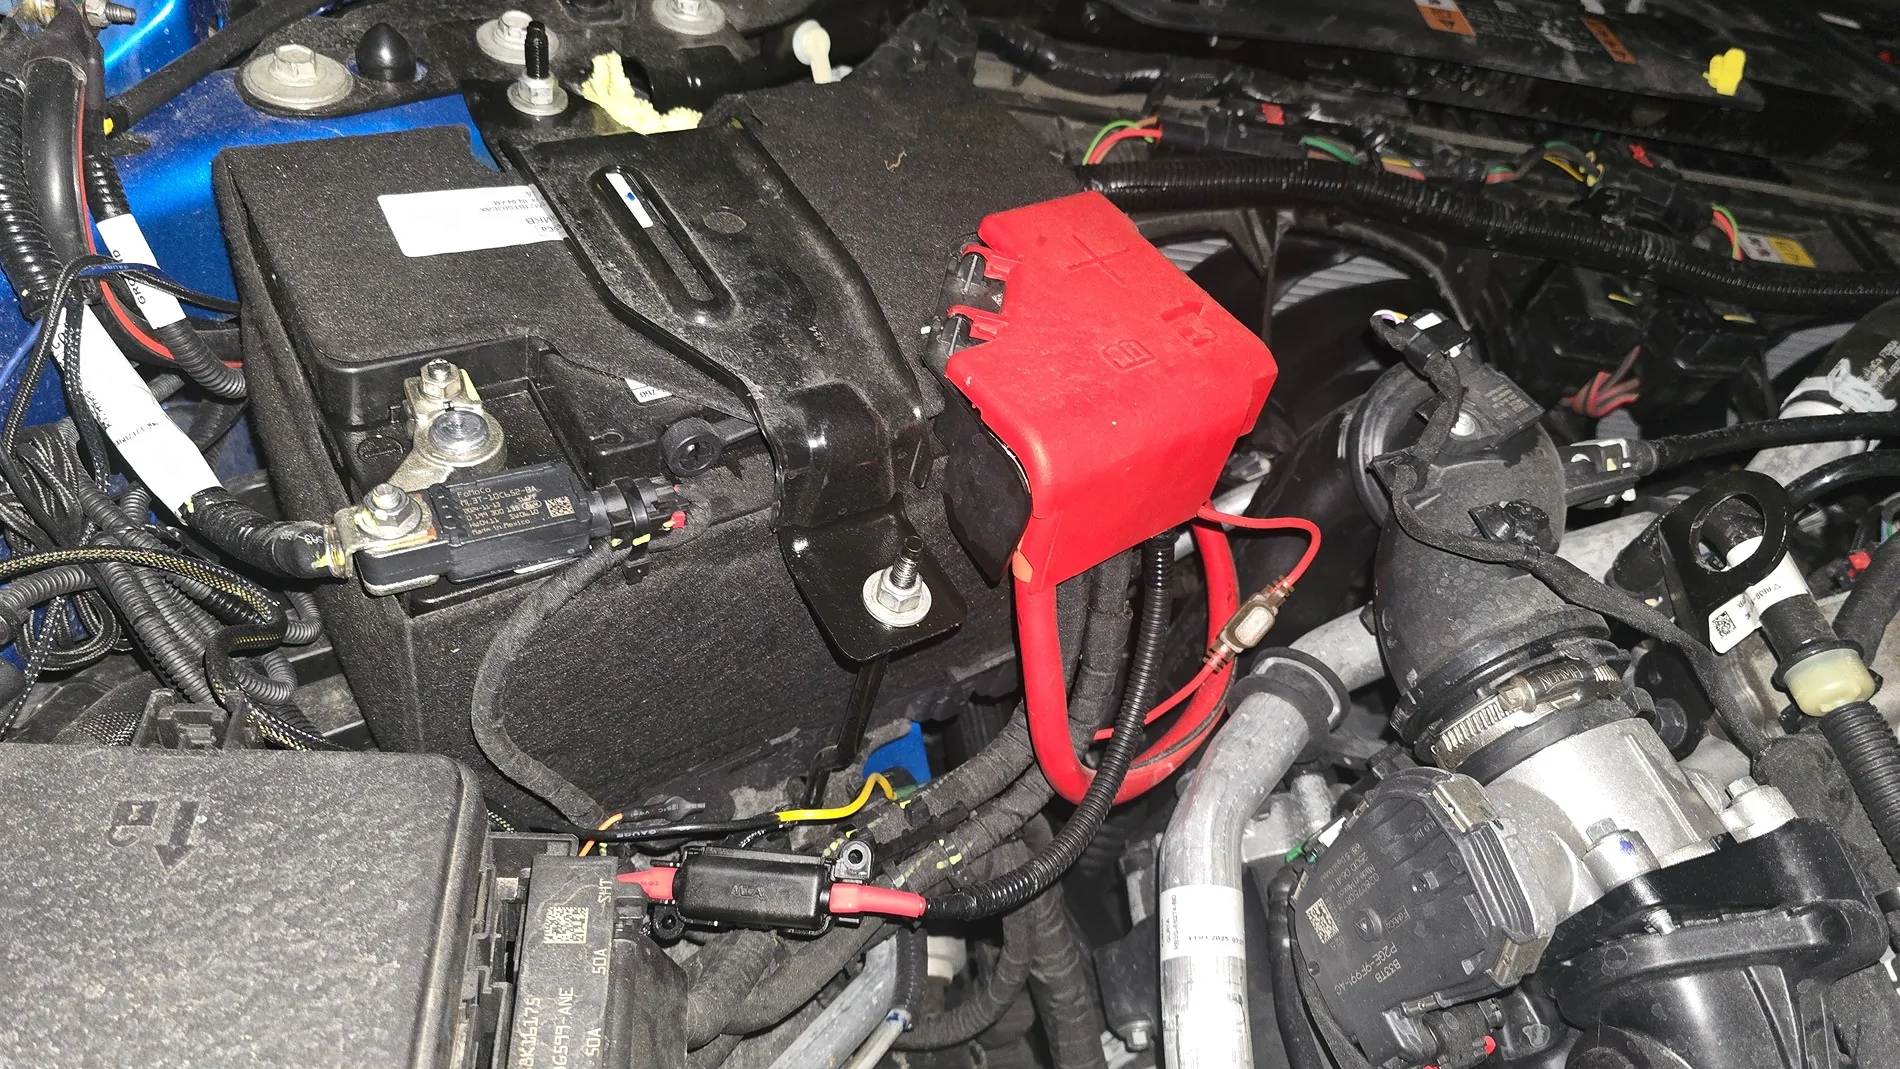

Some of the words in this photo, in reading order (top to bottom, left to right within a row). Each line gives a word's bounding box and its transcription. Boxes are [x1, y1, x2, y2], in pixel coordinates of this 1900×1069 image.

[456, 487, 492, 499] FoMoCo
[591, 947, 608, 975] 50A
[585, 1026, 602, 1057] 50A
